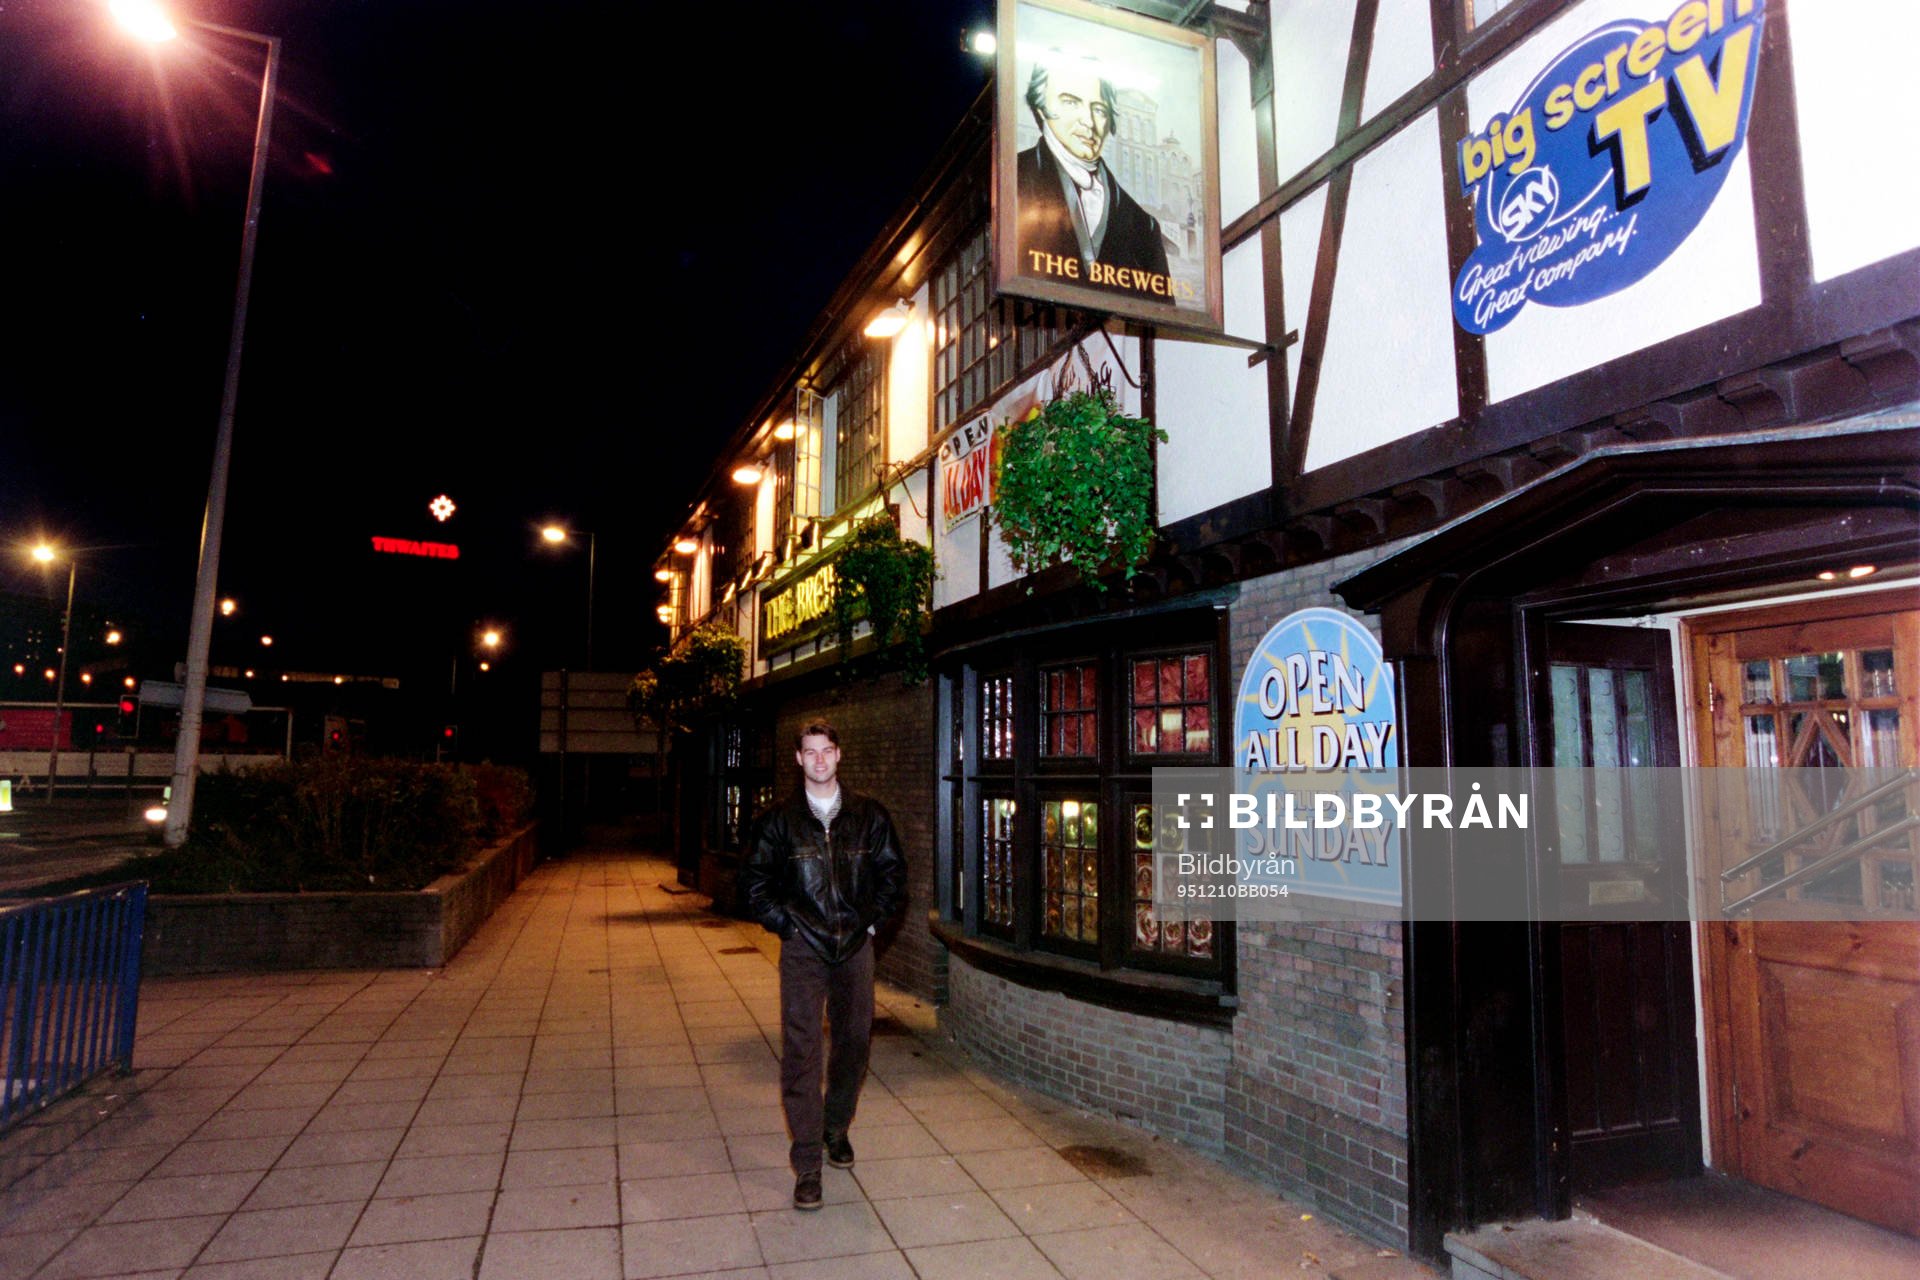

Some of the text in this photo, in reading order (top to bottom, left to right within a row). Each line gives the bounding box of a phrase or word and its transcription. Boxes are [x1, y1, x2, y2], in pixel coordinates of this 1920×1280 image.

[1462, 107, 1536, 187] big
[1592, 25, 1754, 202] TV
[1502, 165, 1554, 243] SKY
[1028, 249, 1195, 299] THE BREWERS
[1459, 245, 1521, 305] Great
[1474, 213, 1638, 328] Great company.
[941, 415, 988, 462] OPEN
[960, 445, 987, 512] DAY
[1258, 649, 1366, 720] OPEN
[1245, 720, 1392, 775] ALL DAY
[1247, 814, 1394, 868] SUNDAY
